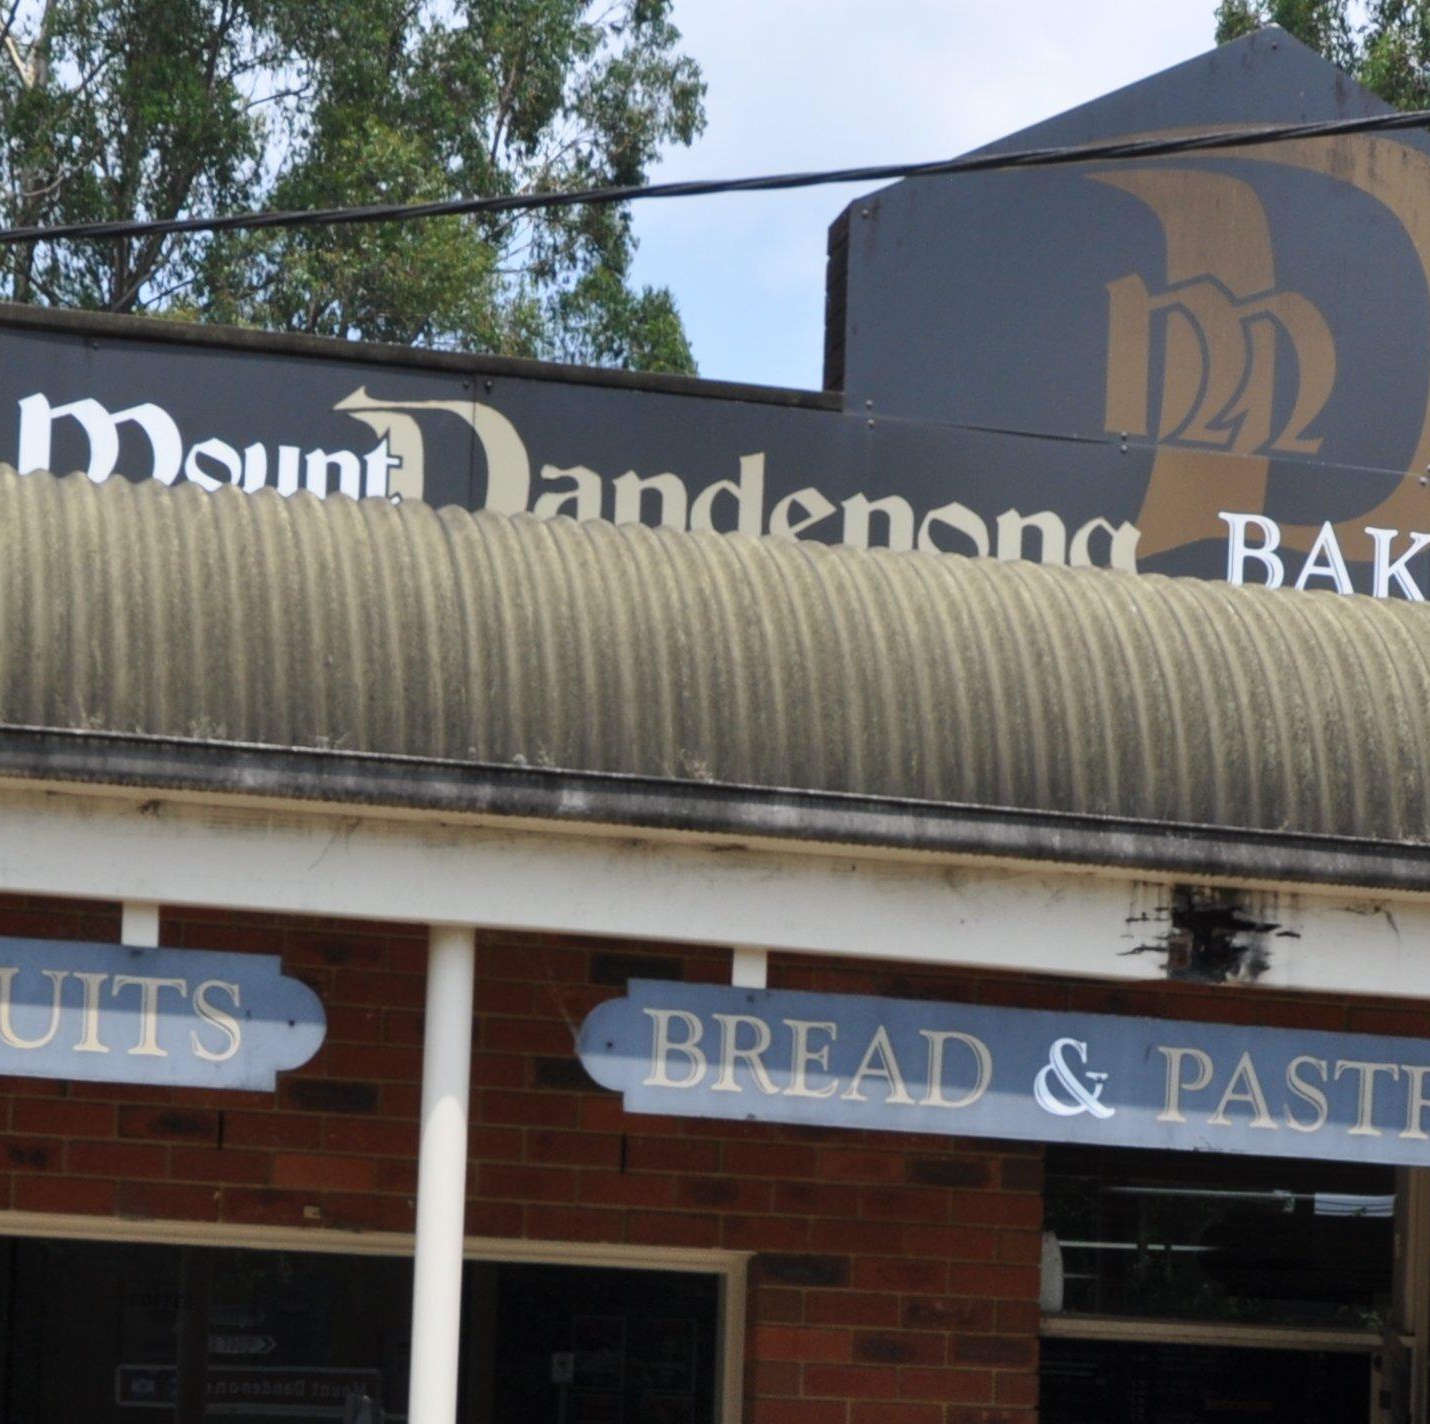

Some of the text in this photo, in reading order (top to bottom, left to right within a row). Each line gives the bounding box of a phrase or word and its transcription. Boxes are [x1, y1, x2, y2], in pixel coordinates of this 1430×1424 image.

[18, 392, 401, 506] Mount
[642, 1007, 994, 1109] BREAD
[1033, 1036, 1116, 1120] &
